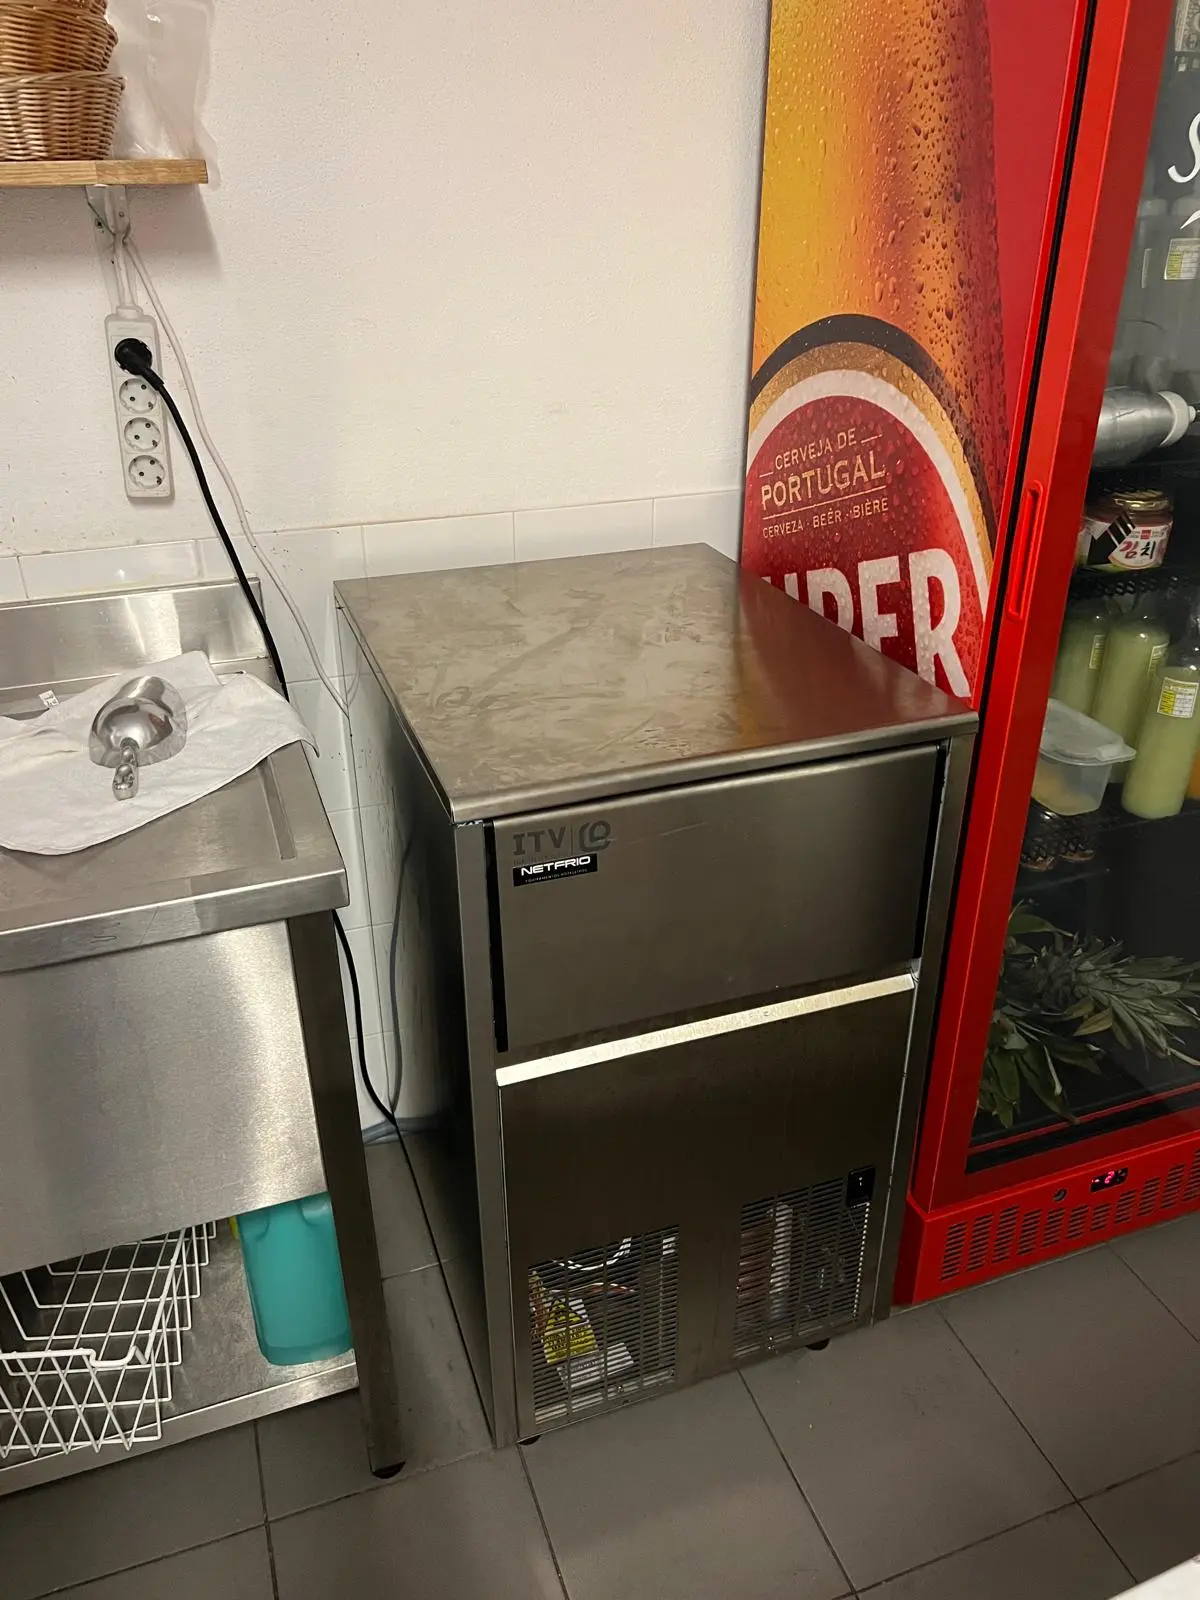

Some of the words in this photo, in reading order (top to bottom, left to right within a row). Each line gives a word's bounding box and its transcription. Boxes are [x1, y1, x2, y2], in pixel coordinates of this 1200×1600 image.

[775, 437, 833, 470] CERVEJA
[837, 428, 857, 449] DE
[761, 450, 886, 511] PORTUGAL
[762, 519, 804, 539] CERVEZA
[812, 509, 842, 528] BEER
[852, 498, 889, 519] BIÈRE
[1119, 540, 1156, 559] 김치
[513, 826, 566, 855] ITV
[521, 855, 591, 876] NETFRIO
